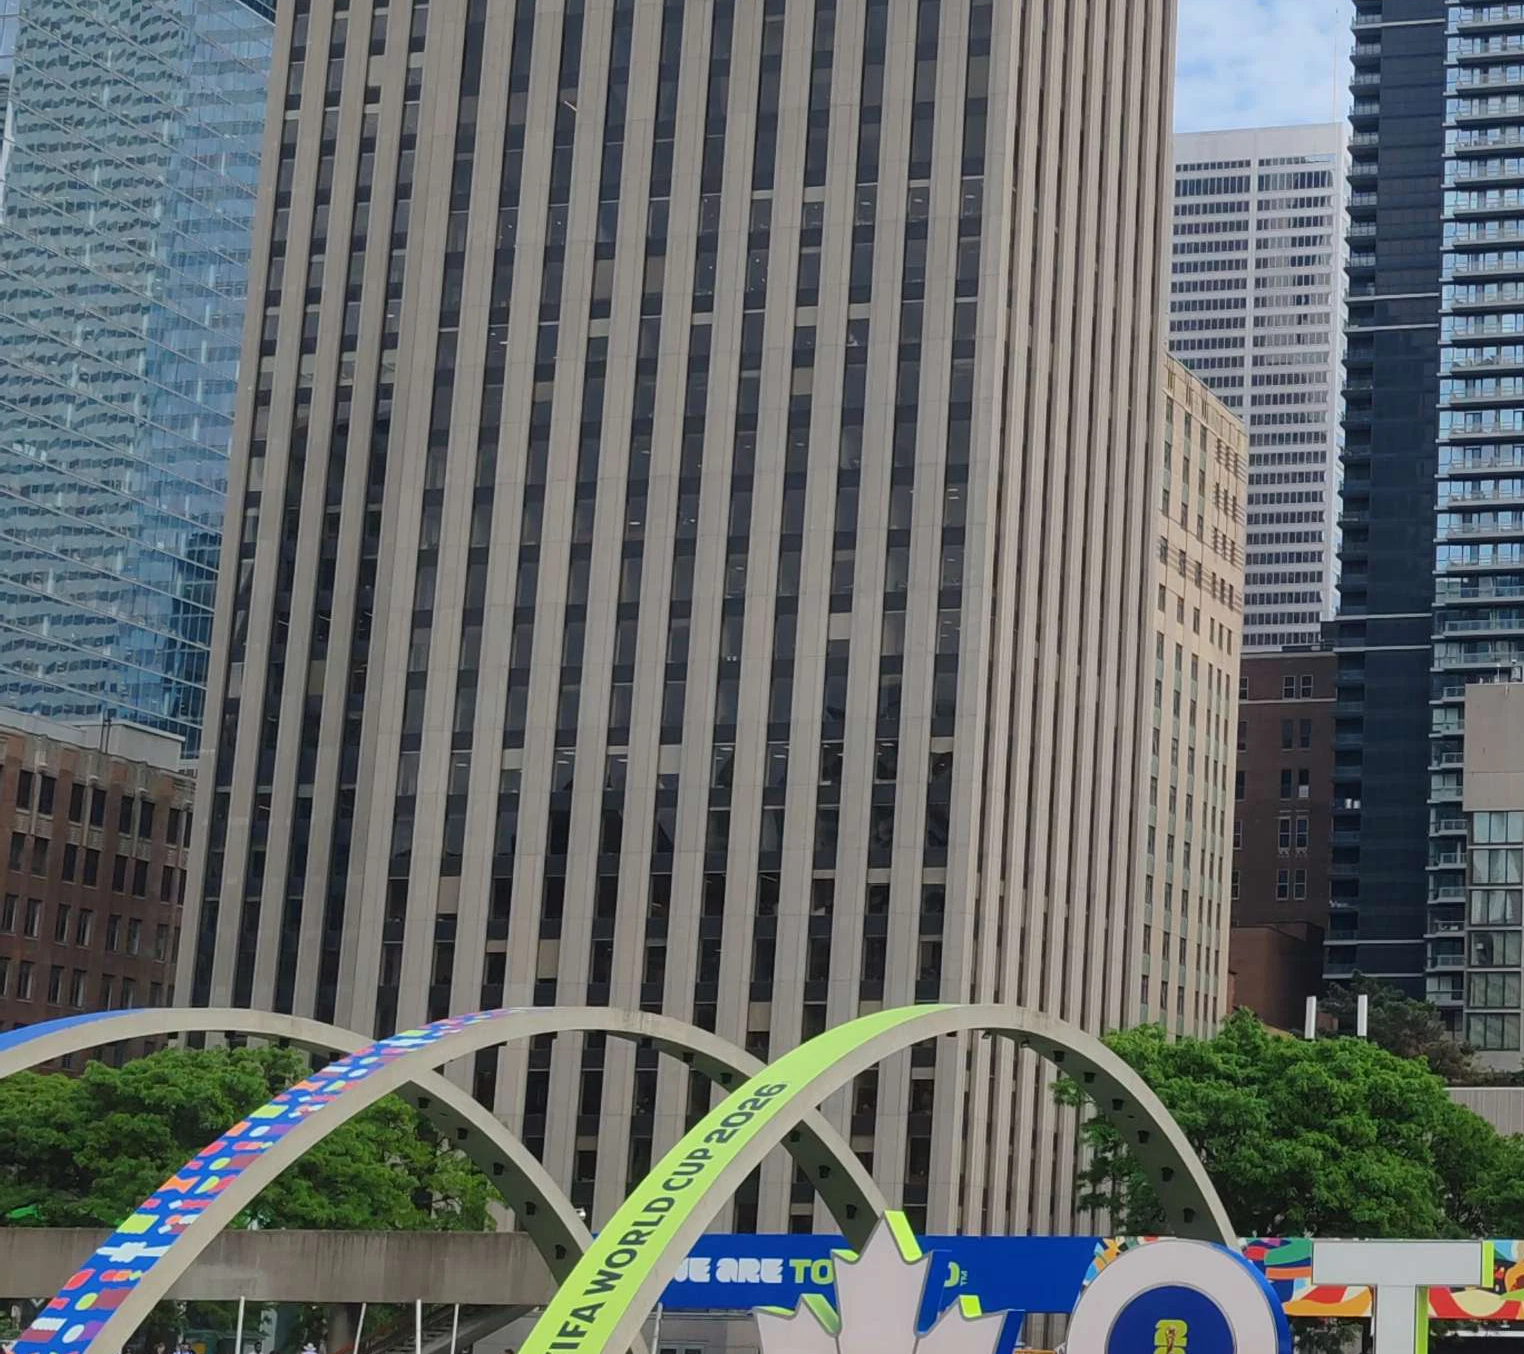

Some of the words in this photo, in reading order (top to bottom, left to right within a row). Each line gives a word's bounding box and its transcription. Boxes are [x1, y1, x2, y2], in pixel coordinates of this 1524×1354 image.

[582, 1196, 676, 1296] WORLD
[662, 1147, 714, 1192] CUP
[703, 1083, 788, 1144] 2026
[715, 1257, 785, 1284] ARE
